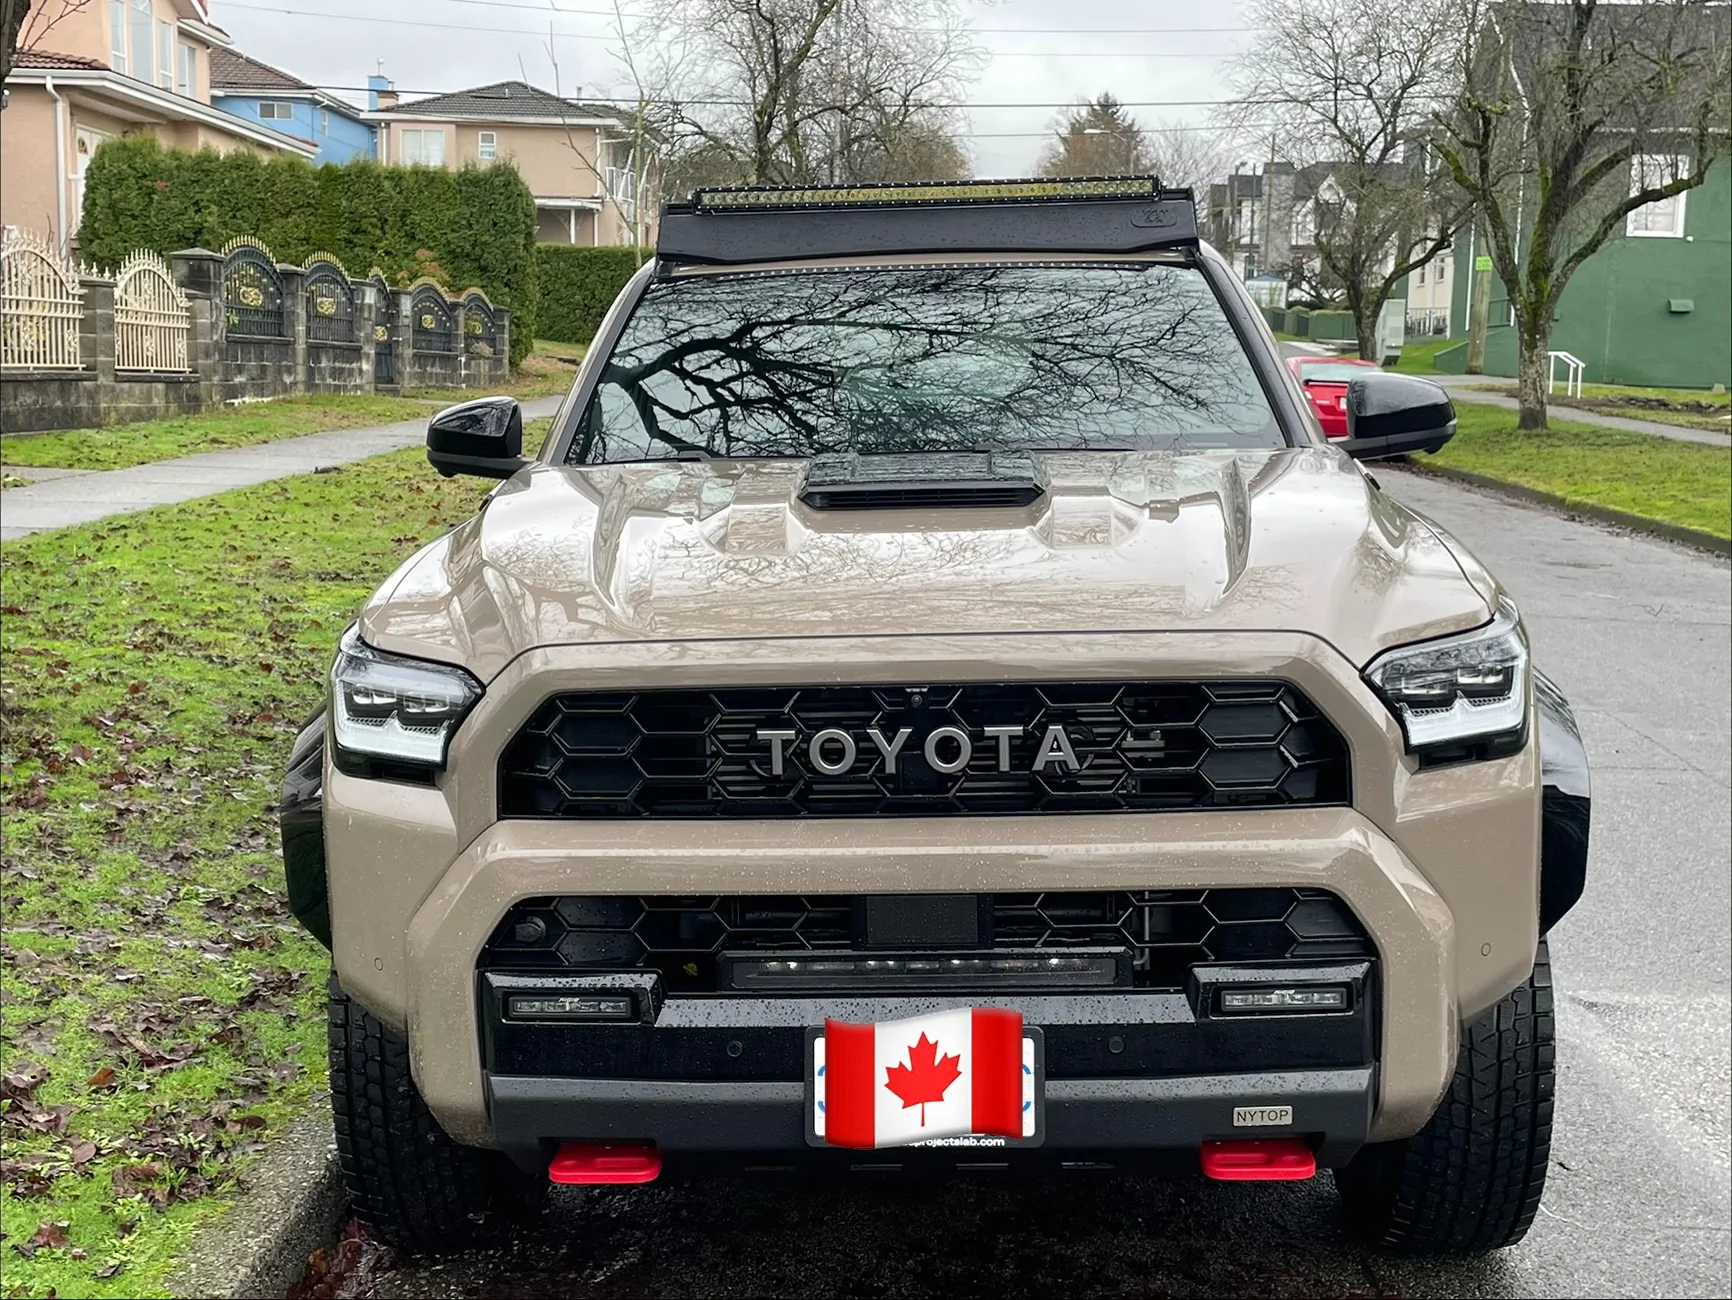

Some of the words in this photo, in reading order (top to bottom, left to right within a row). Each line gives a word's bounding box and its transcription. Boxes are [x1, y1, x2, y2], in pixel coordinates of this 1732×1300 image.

[756, 725, 1081, 776] TOYOTA
[1237, 1109, 1289, 1122] NYTOP
[903, 1136, 1005, 1147] projectslab.com
